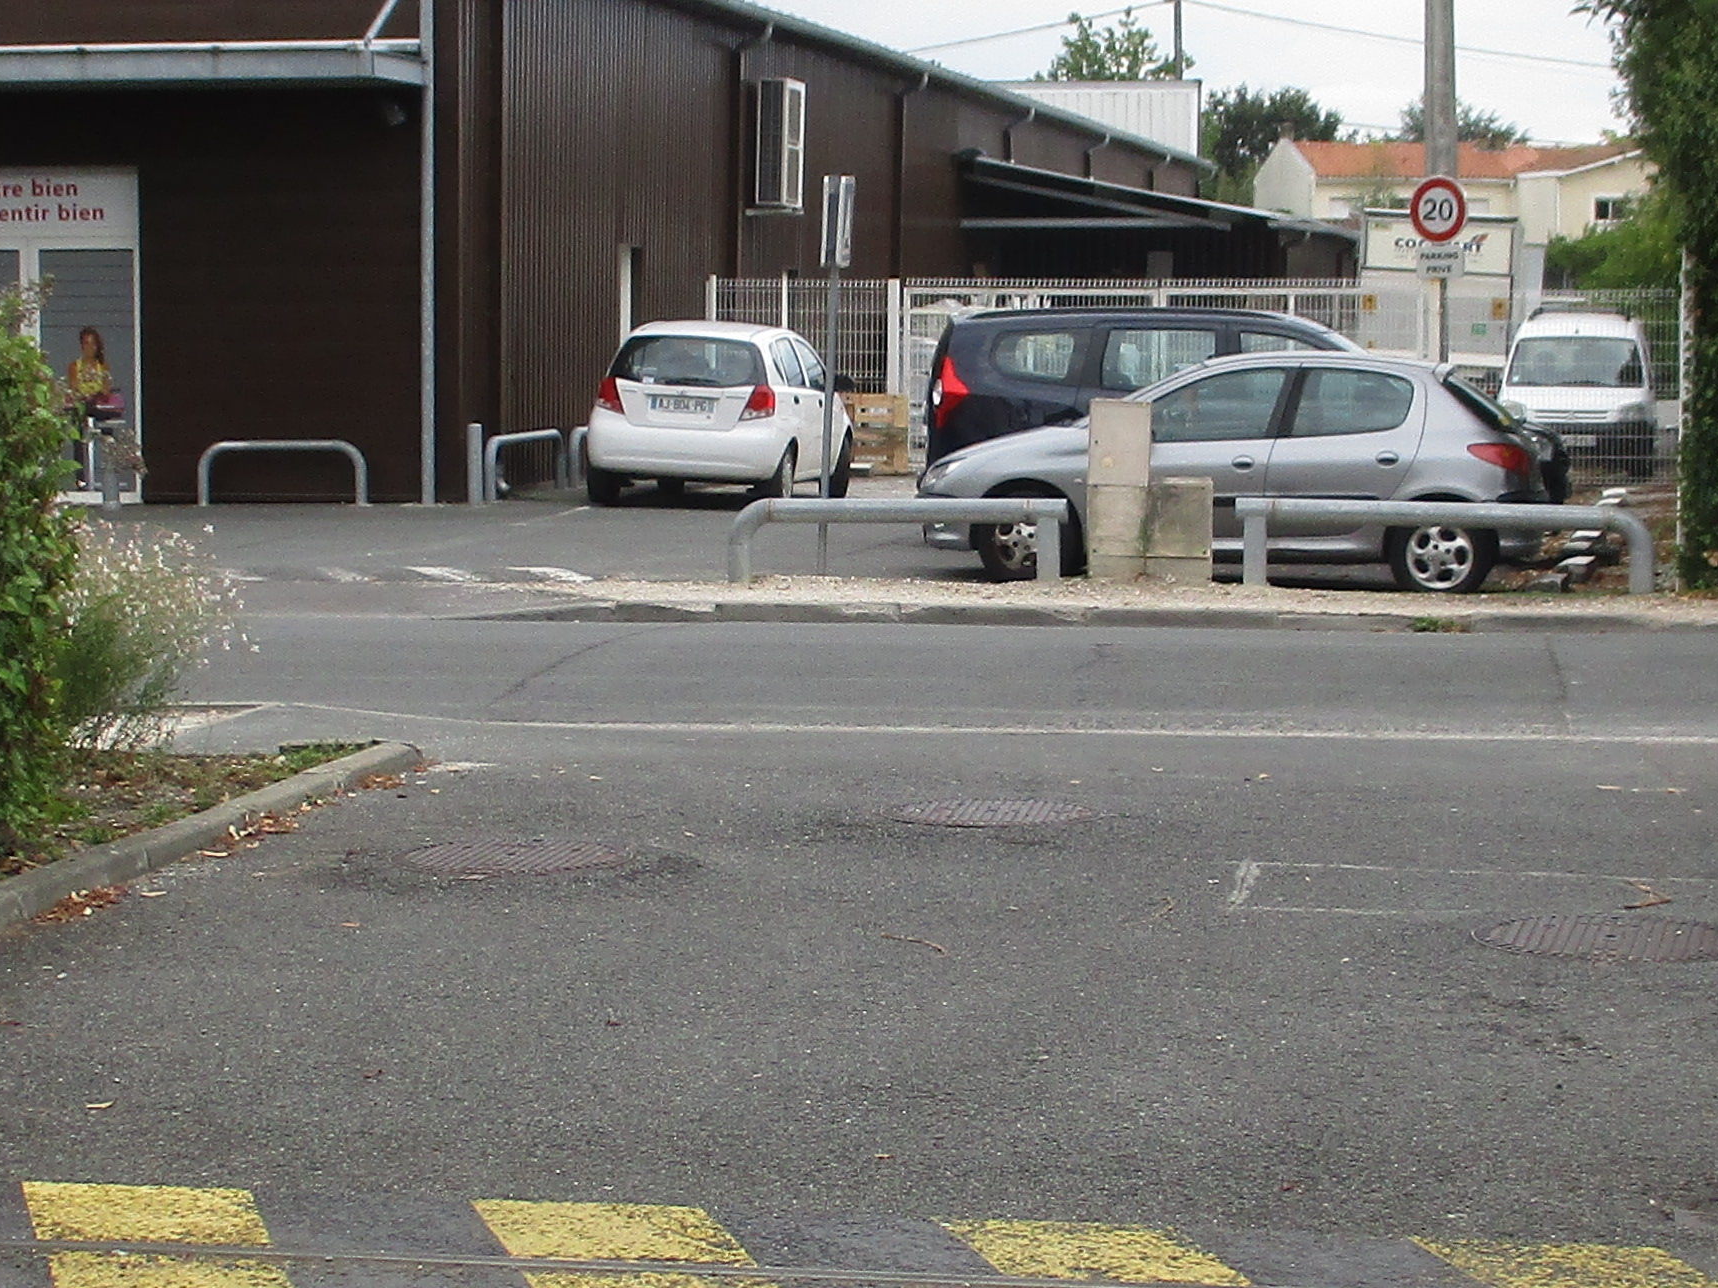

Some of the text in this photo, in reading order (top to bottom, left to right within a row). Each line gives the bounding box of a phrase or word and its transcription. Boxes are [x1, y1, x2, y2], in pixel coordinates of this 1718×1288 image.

[31, 178, 79, 197] bien
[58, 203, 105, 221] bien
[1422, 198, 1453, 221] 20
[1420, 252, 1459, 261] PARKING
